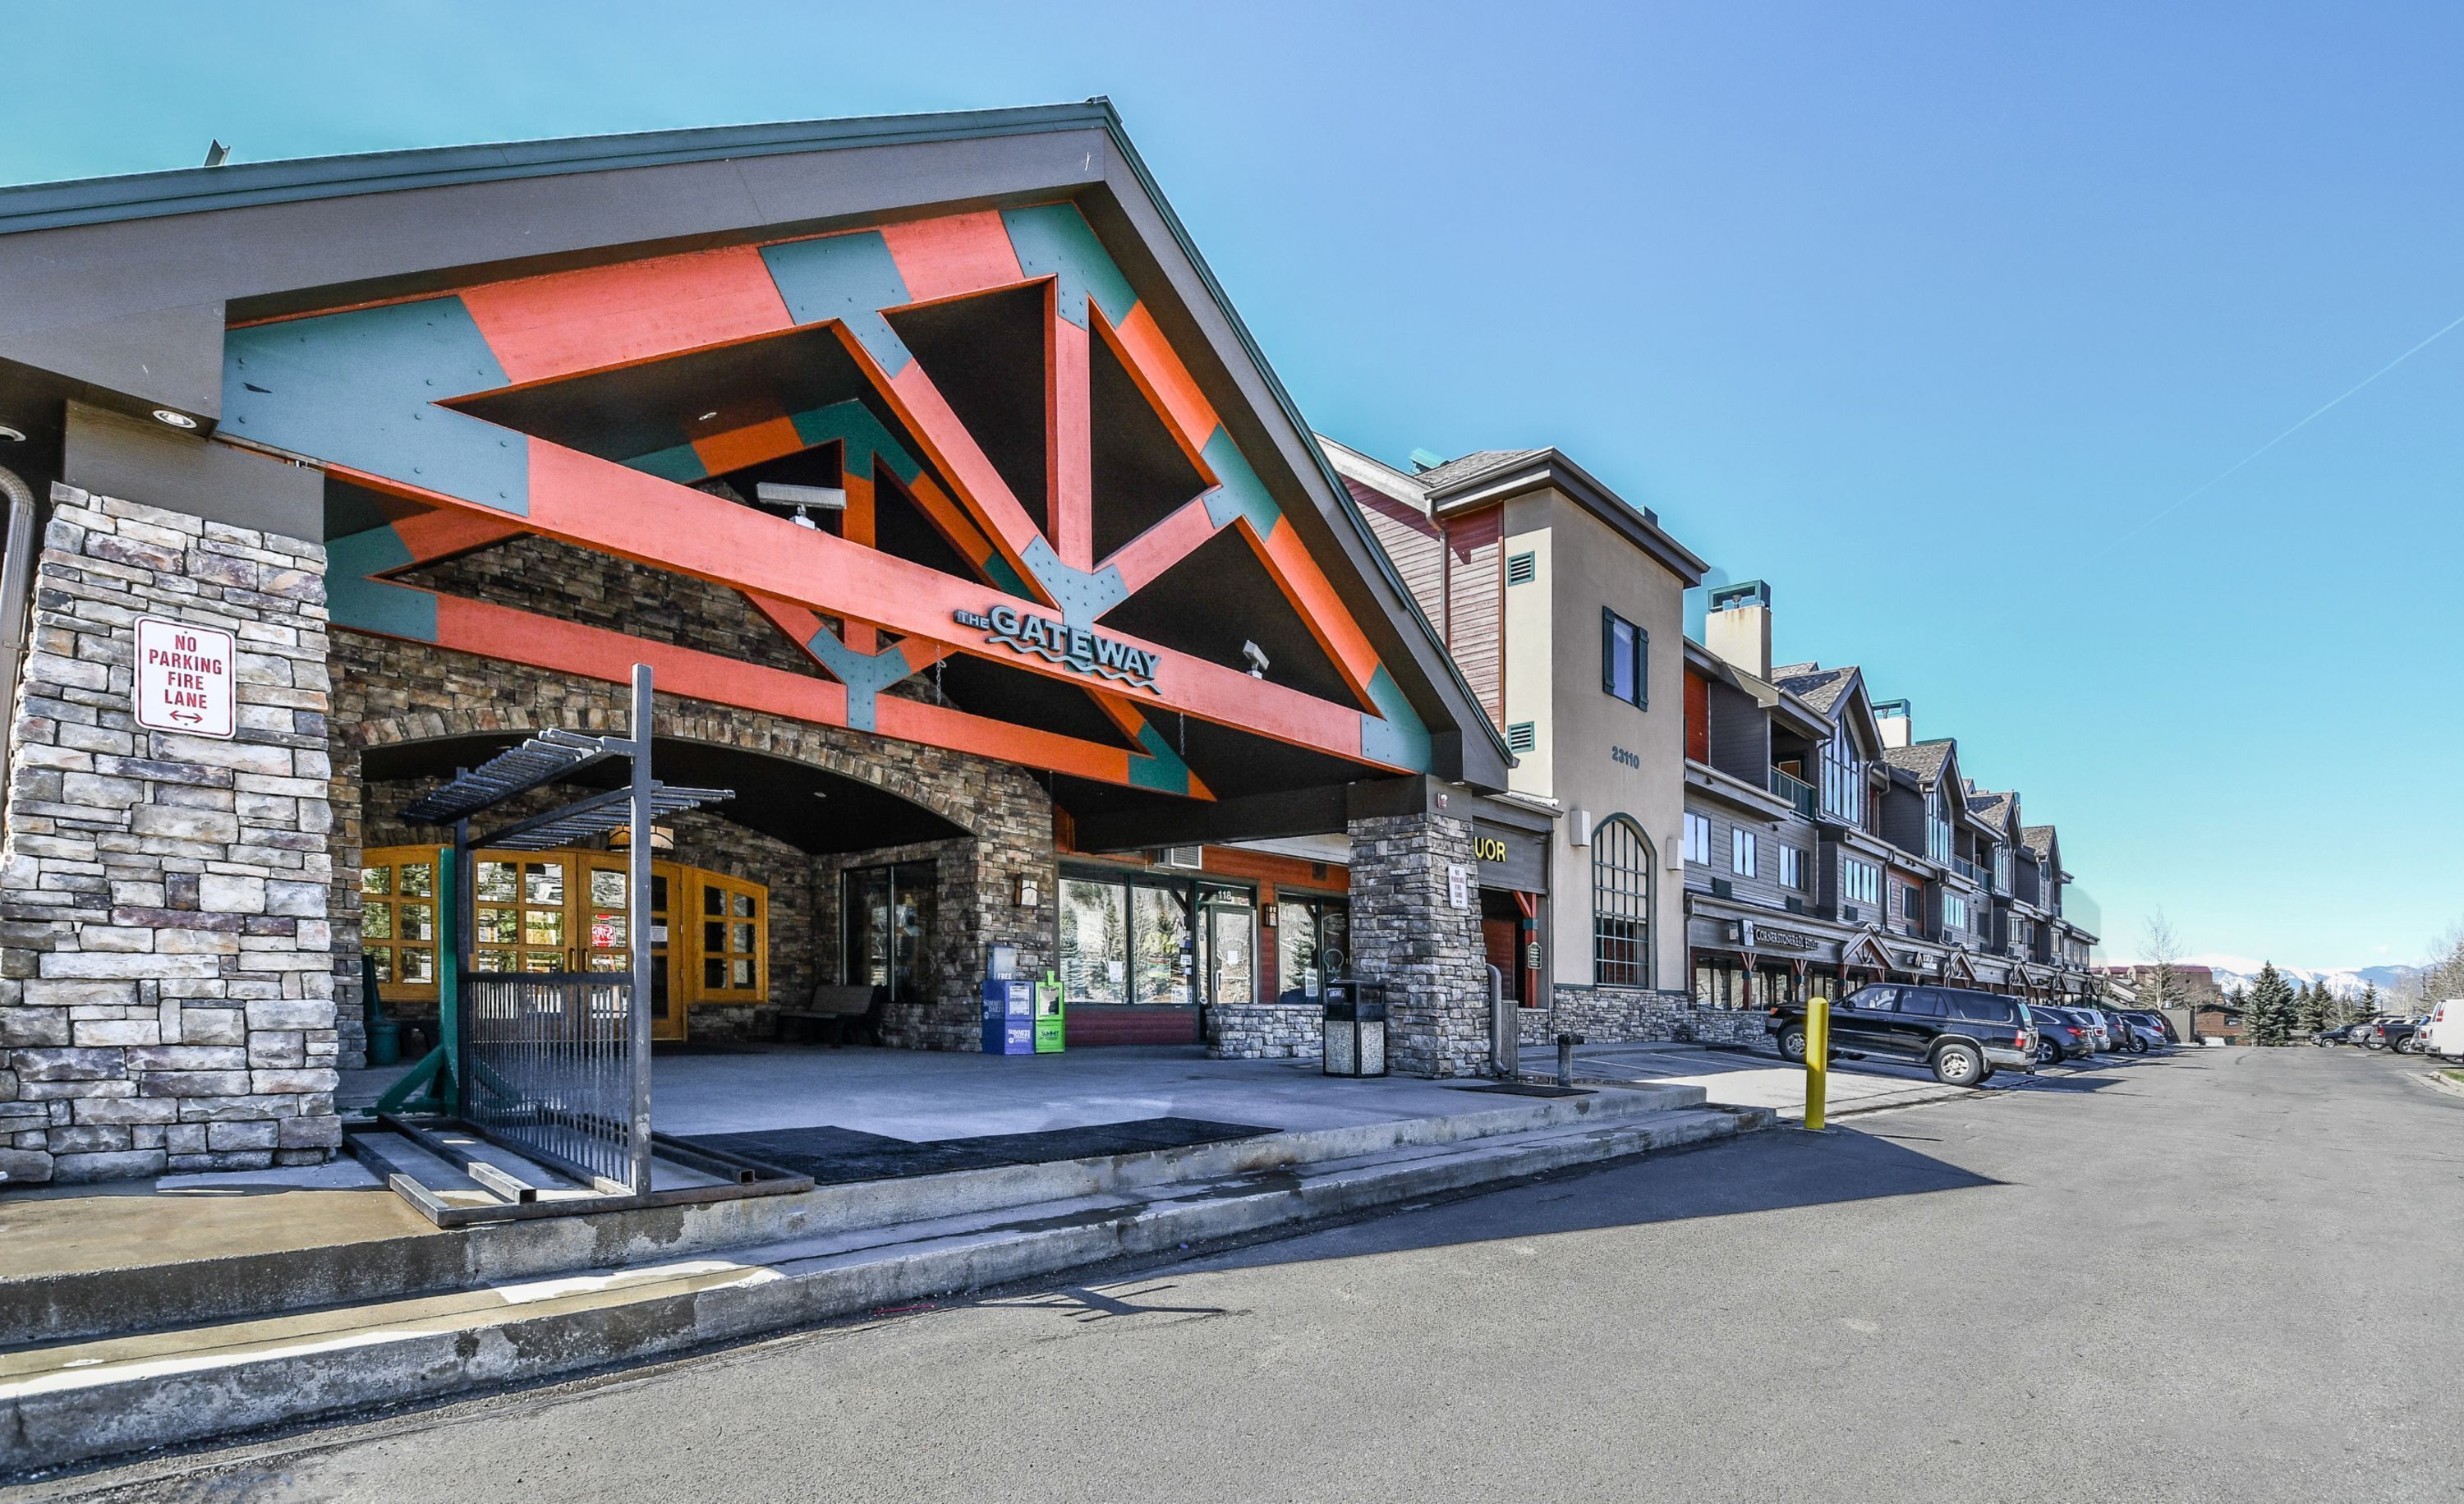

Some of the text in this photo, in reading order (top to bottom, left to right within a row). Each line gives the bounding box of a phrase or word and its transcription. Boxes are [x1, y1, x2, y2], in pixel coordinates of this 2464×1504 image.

[175, 634, 197, 652] NO
[955, 605, 1161, 680] THE GATEWAY
[149, 649, 222, 675] PARKING
[168, 671, 205, 691] FIRE
[164, 689, 208, 710] LANE
[1611, 745, 1640, 770] 23110
[1218, 890, 1232, 900] 118
